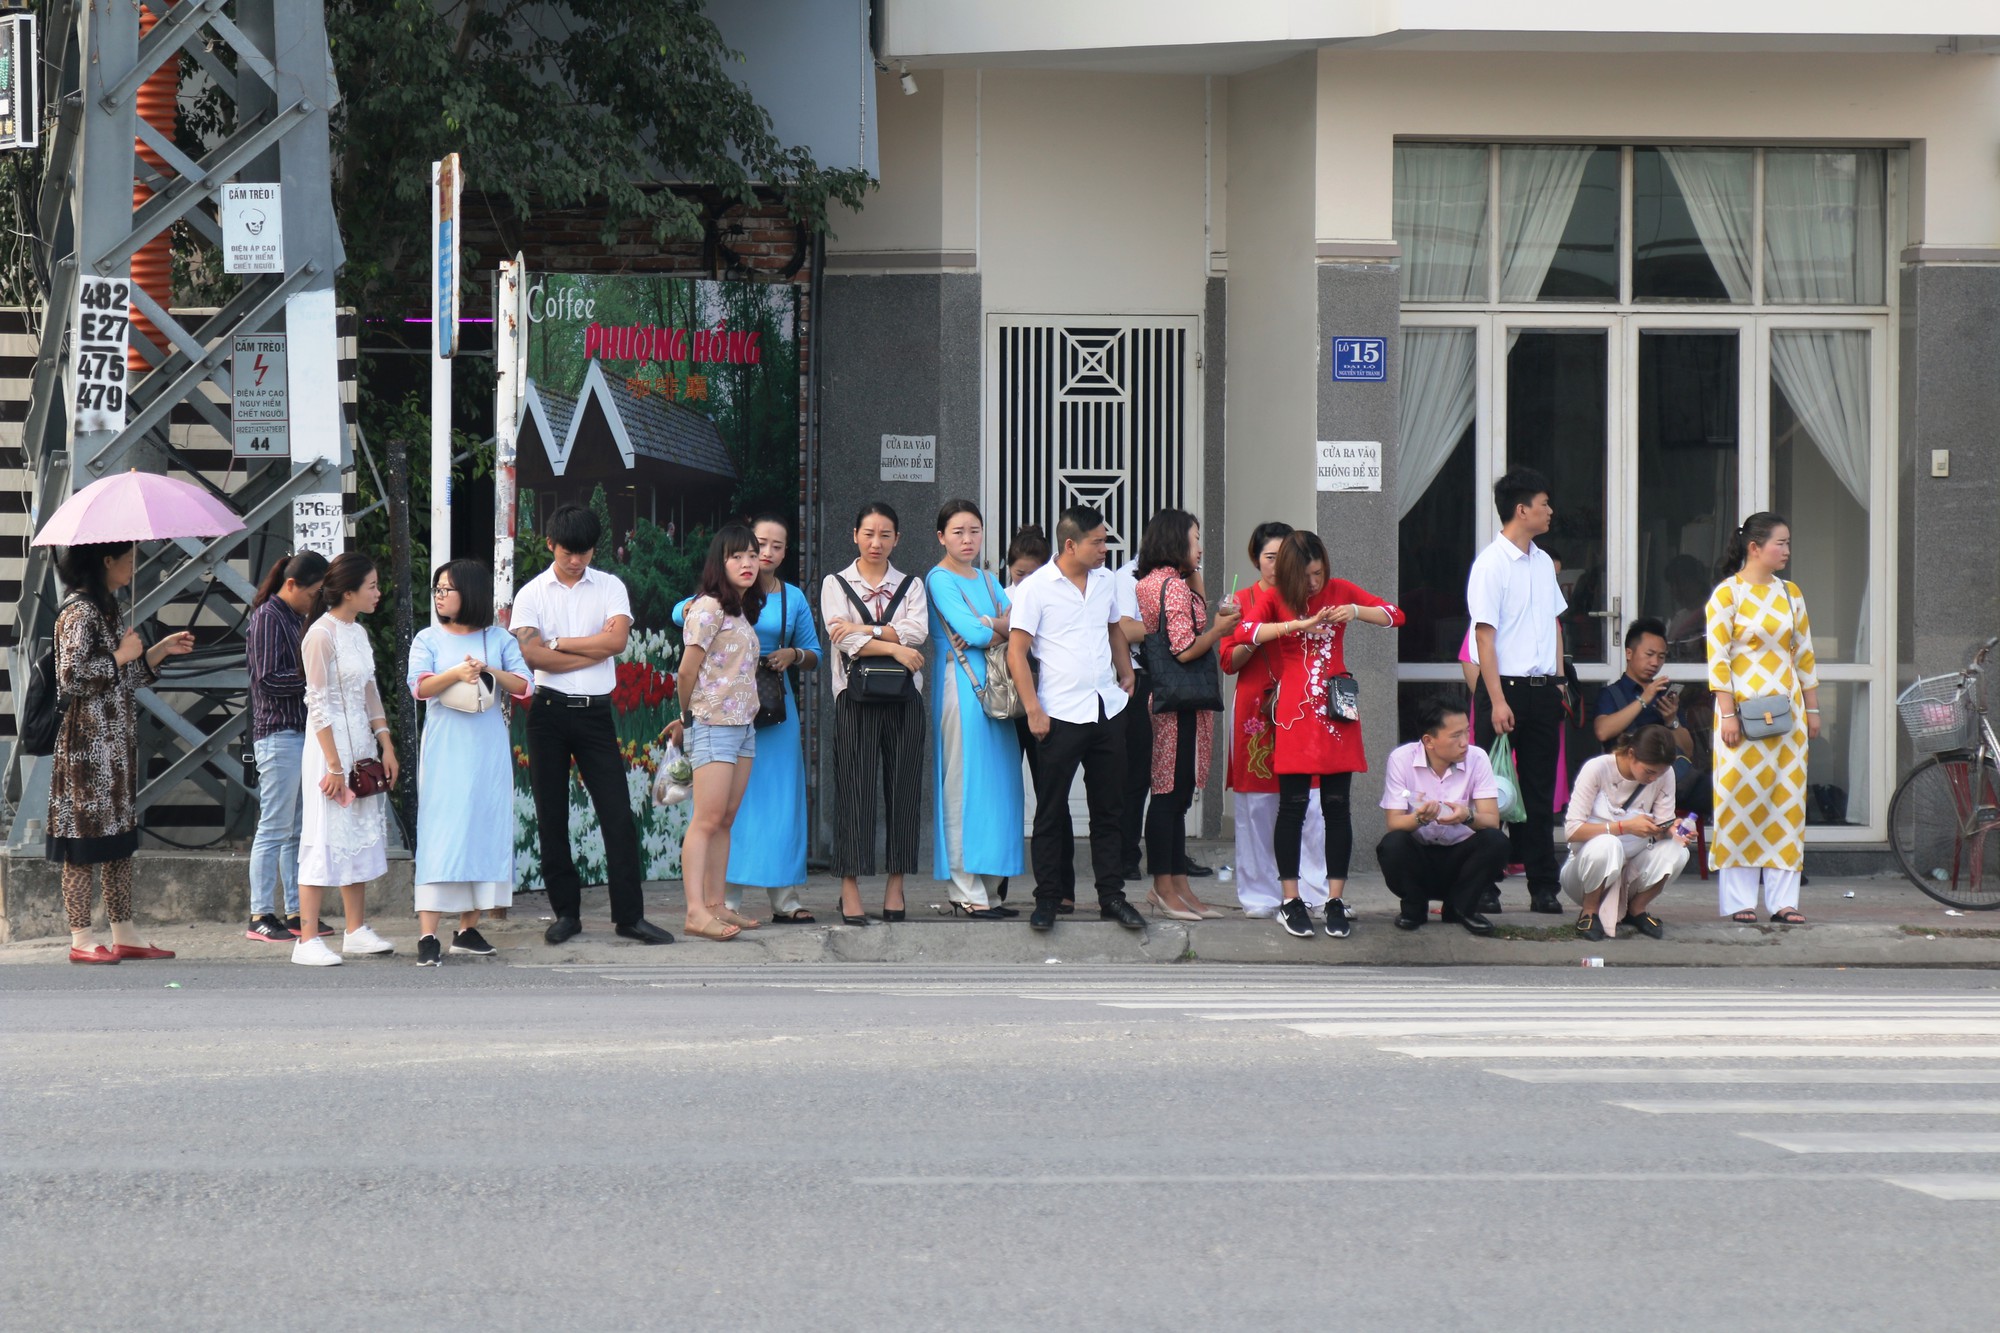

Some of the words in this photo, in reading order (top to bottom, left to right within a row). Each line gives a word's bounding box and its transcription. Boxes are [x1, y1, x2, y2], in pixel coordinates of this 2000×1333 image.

[229, 187, 246, 199] CẤM
[231, 244, 248, 252] ĐIỆN
[80, 282, 129, 311] 482
[526, 285, 596, 323] Coffee
[80, 313, 129, 342] E27
[235, 338, 255, 352] CẤM
[583, 321, 687, 367] PHƯỢNG
[692, 316, 762, 365] HỒNG
[1350, 342, 1379, 363] 15
[77, 353, 125, 382] 475
[76, 382, 123, 412] 479
[236, 388, 255, 398] ĐIỆN
[256, 388, 267, 397] ÁP
[238, 408, 258, 418] CHẾT
[250, 437, 270, 451] 44
[886, 436, 901, 449] CỬA
[903, 440, 913, 449] RA
[915, 438, 931, 449] VÀO
[1322, 445, 1341, 458] CỬA
[1343, 448, 1355, 458] RA
[923, 458, 933, 468] XE
[1318, 463, 1350, 477] KHÔNG
[1367, 466, 1379, 477] XE
